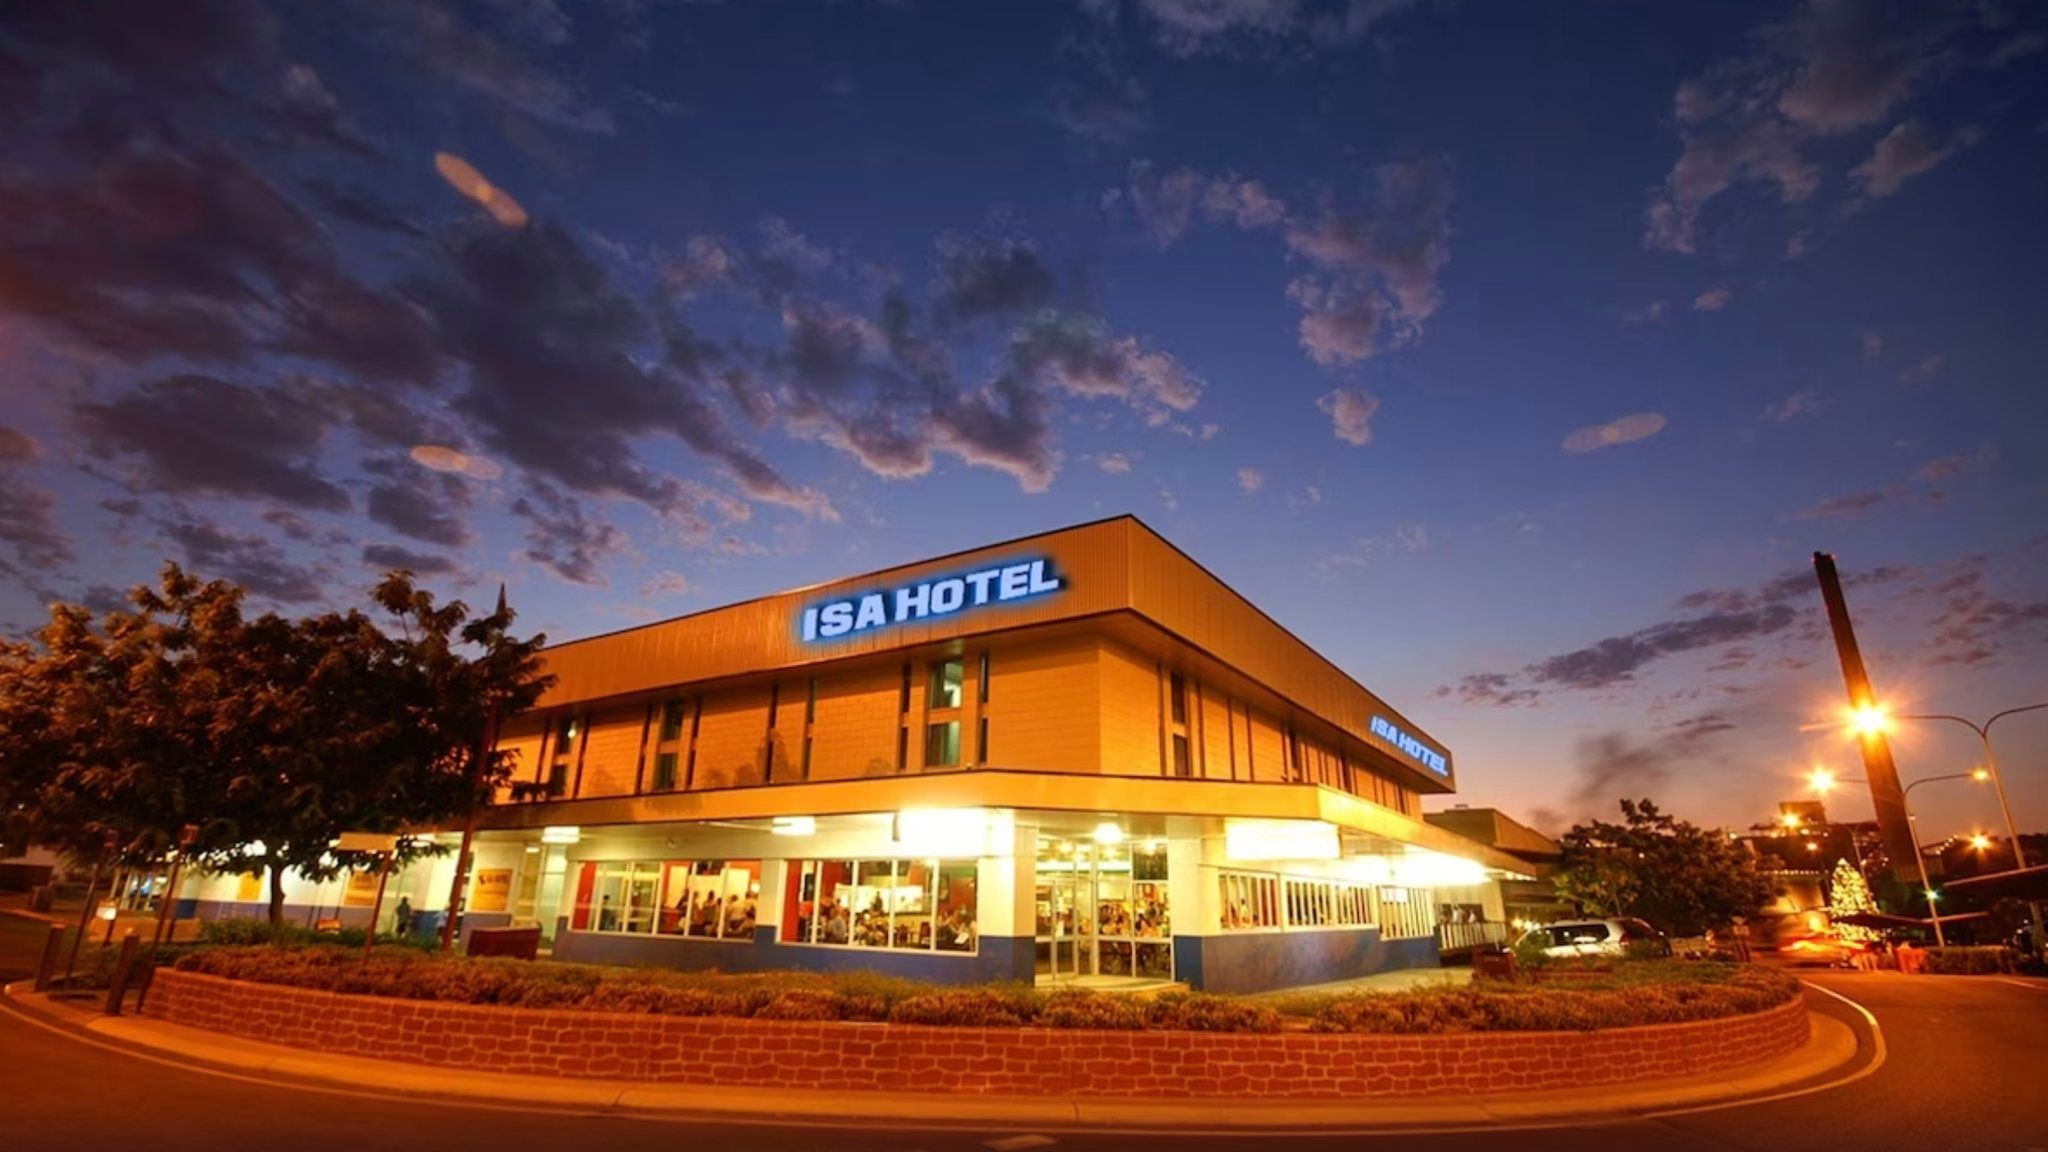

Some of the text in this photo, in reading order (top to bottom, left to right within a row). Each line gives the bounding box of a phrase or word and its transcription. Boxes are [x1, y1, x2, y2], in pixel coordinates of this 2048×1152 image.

[802, 559, 1059, 642] ISA HOTEL
[1370, 716, 1449, 776] ISA HOTEL
